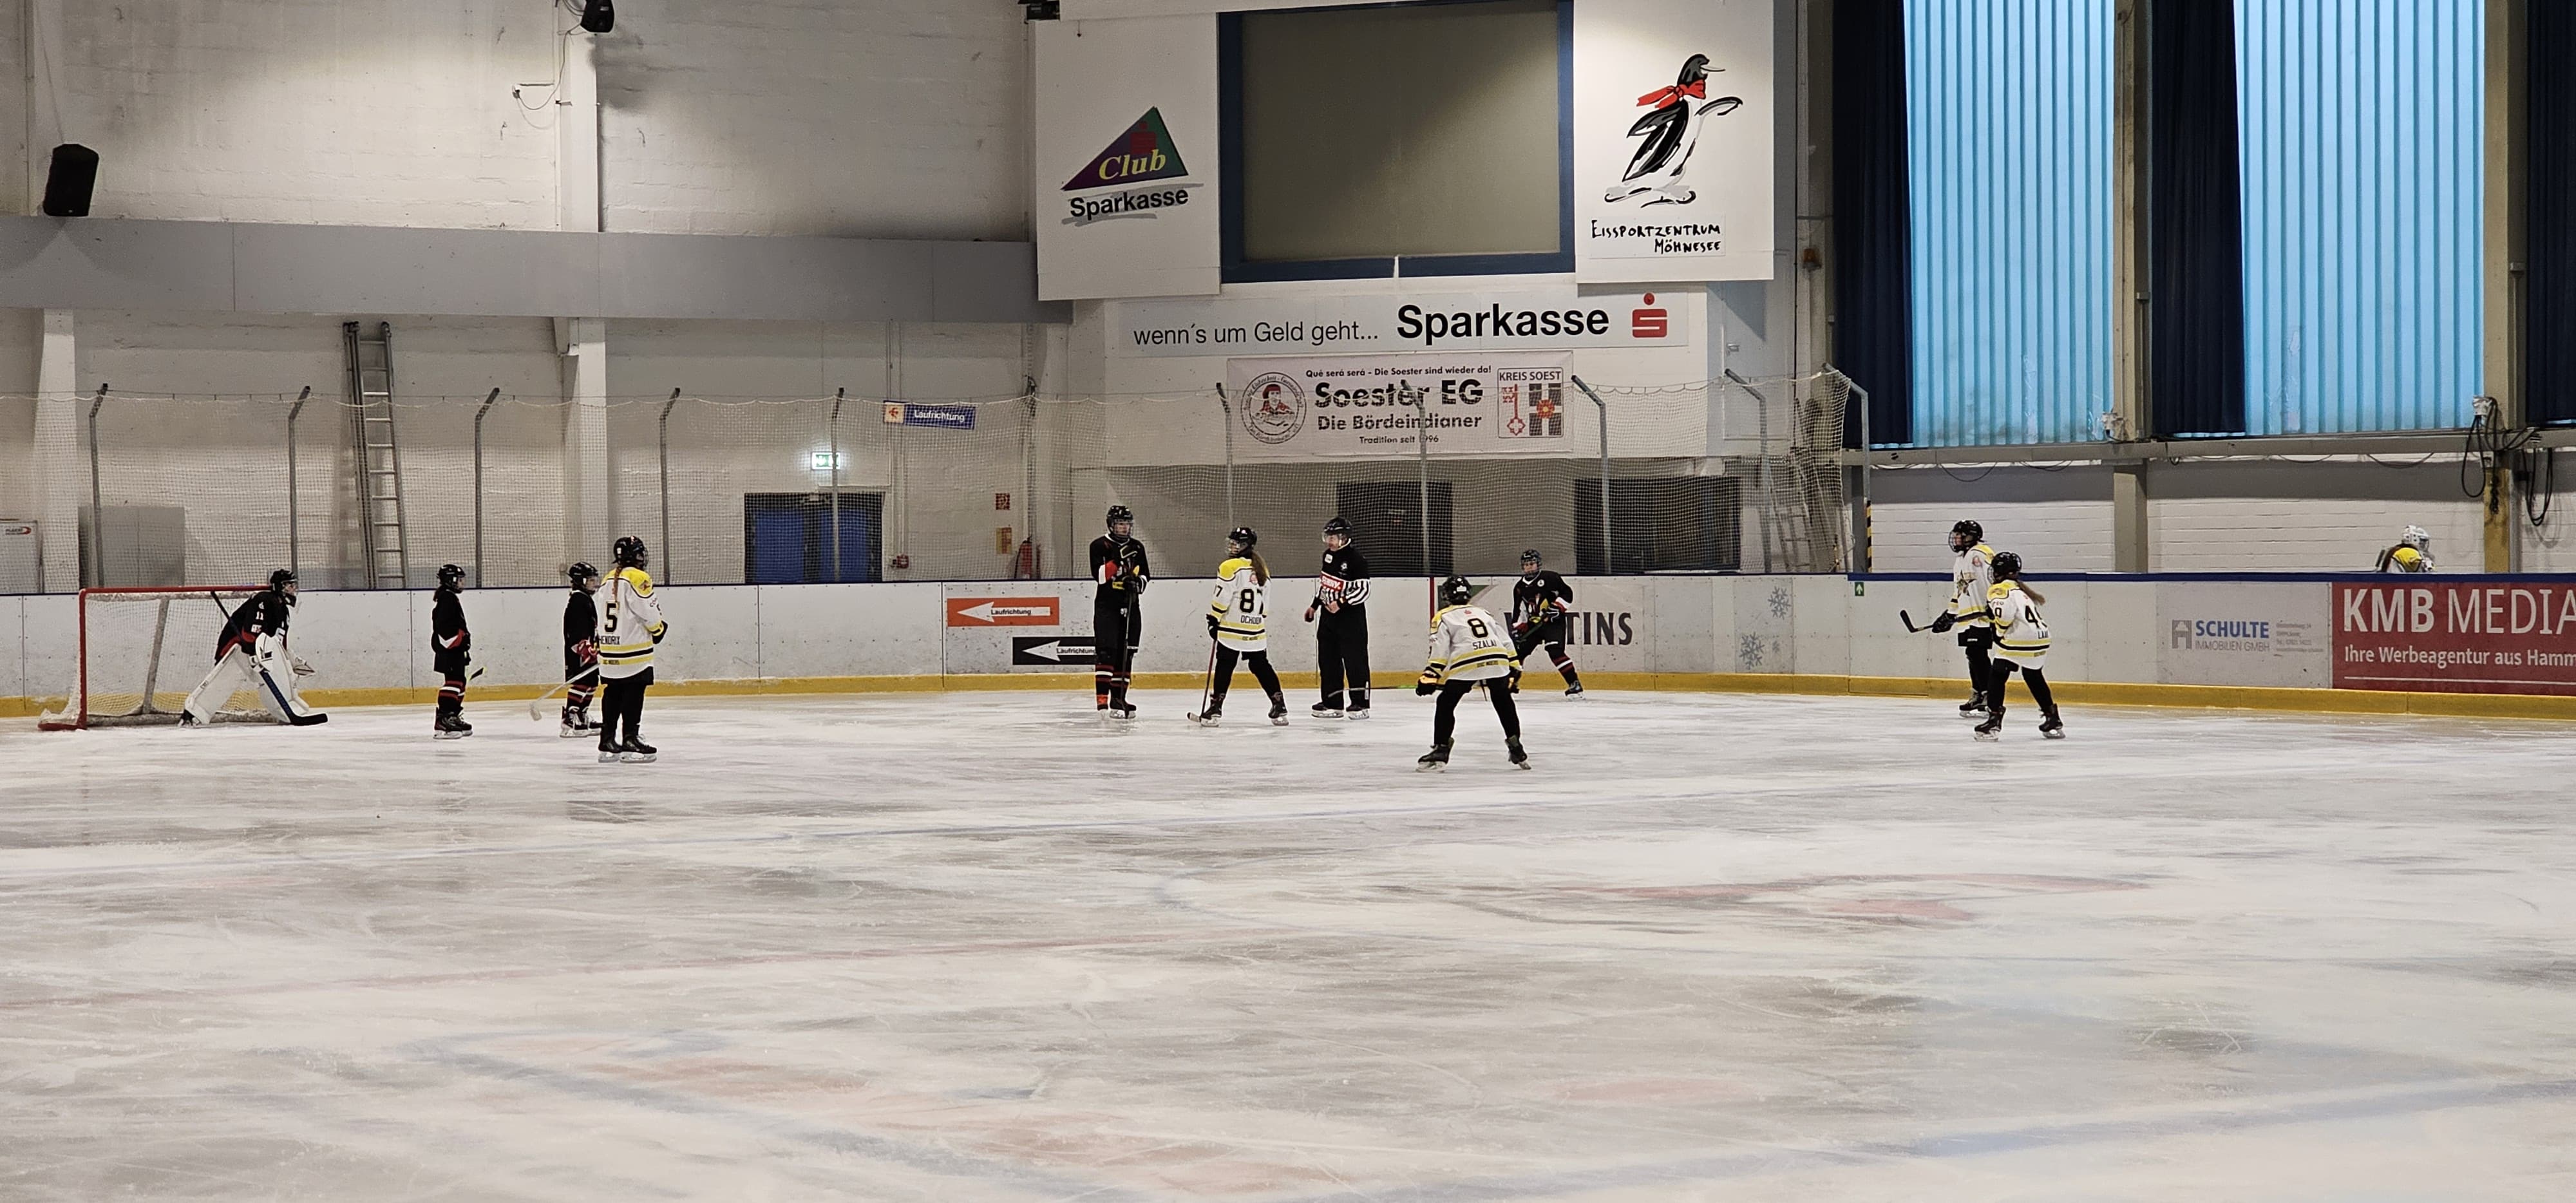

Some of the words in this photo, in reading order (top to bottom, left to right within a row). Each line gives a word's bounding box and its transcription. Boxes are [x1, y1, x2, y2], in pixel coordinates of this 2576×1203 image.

[1099, 149, 1166, 180] Club
[1070, 189, 1188, 220] Sparkasse
[1215, 327, 1247, 343] um
[1255, 321, 1303, 342] Geld
[1311, 321, 1378, 345] geht...
[1397, 303, 1609, 346] Sparkasse
[1326, 368, 1344, 377] será
[1391, 367, 1422, 375] Soester
[1425, 366, 1443, 374] sind
[1445, 366, 1475, 374] wieder
[1477, 365, 1492, 374] da!
[1499, 372, 1527, 381] KREIS
[1530, 371, 1561, 381] SOEST
[1315, 382, 1430, 408] Soester
[1441, 379, 1483, 405] EG
[914, 409, 965, 422] Laufrichtung
[1318, 415, 1347, 430] Die
[1353, 413, 1482, 430] Bördeindianer
[1359, 435, 1397, 444] Tradition
[1240, 588, 1264, 614] 87
[2344, 589, 2435, 633] KMB
[2448, 589, 2576, 634] MEDIA
[604, 602, 619, 633] 5
[1467, 618, 1488, 638] 8
[2195, 620, 2269, 638] SCHULTE
[2195, 640, 2242, 651] IMMOBILIEN
[2244, 641, 2270, 652] GMBH
[2345, 645, 2374, 662] Ihre
[2378, 645, 2490, 669] Werbeagentur
[2495, 652, 2522, 665] aus
[2528, 649, 2576, 667] Hamm
